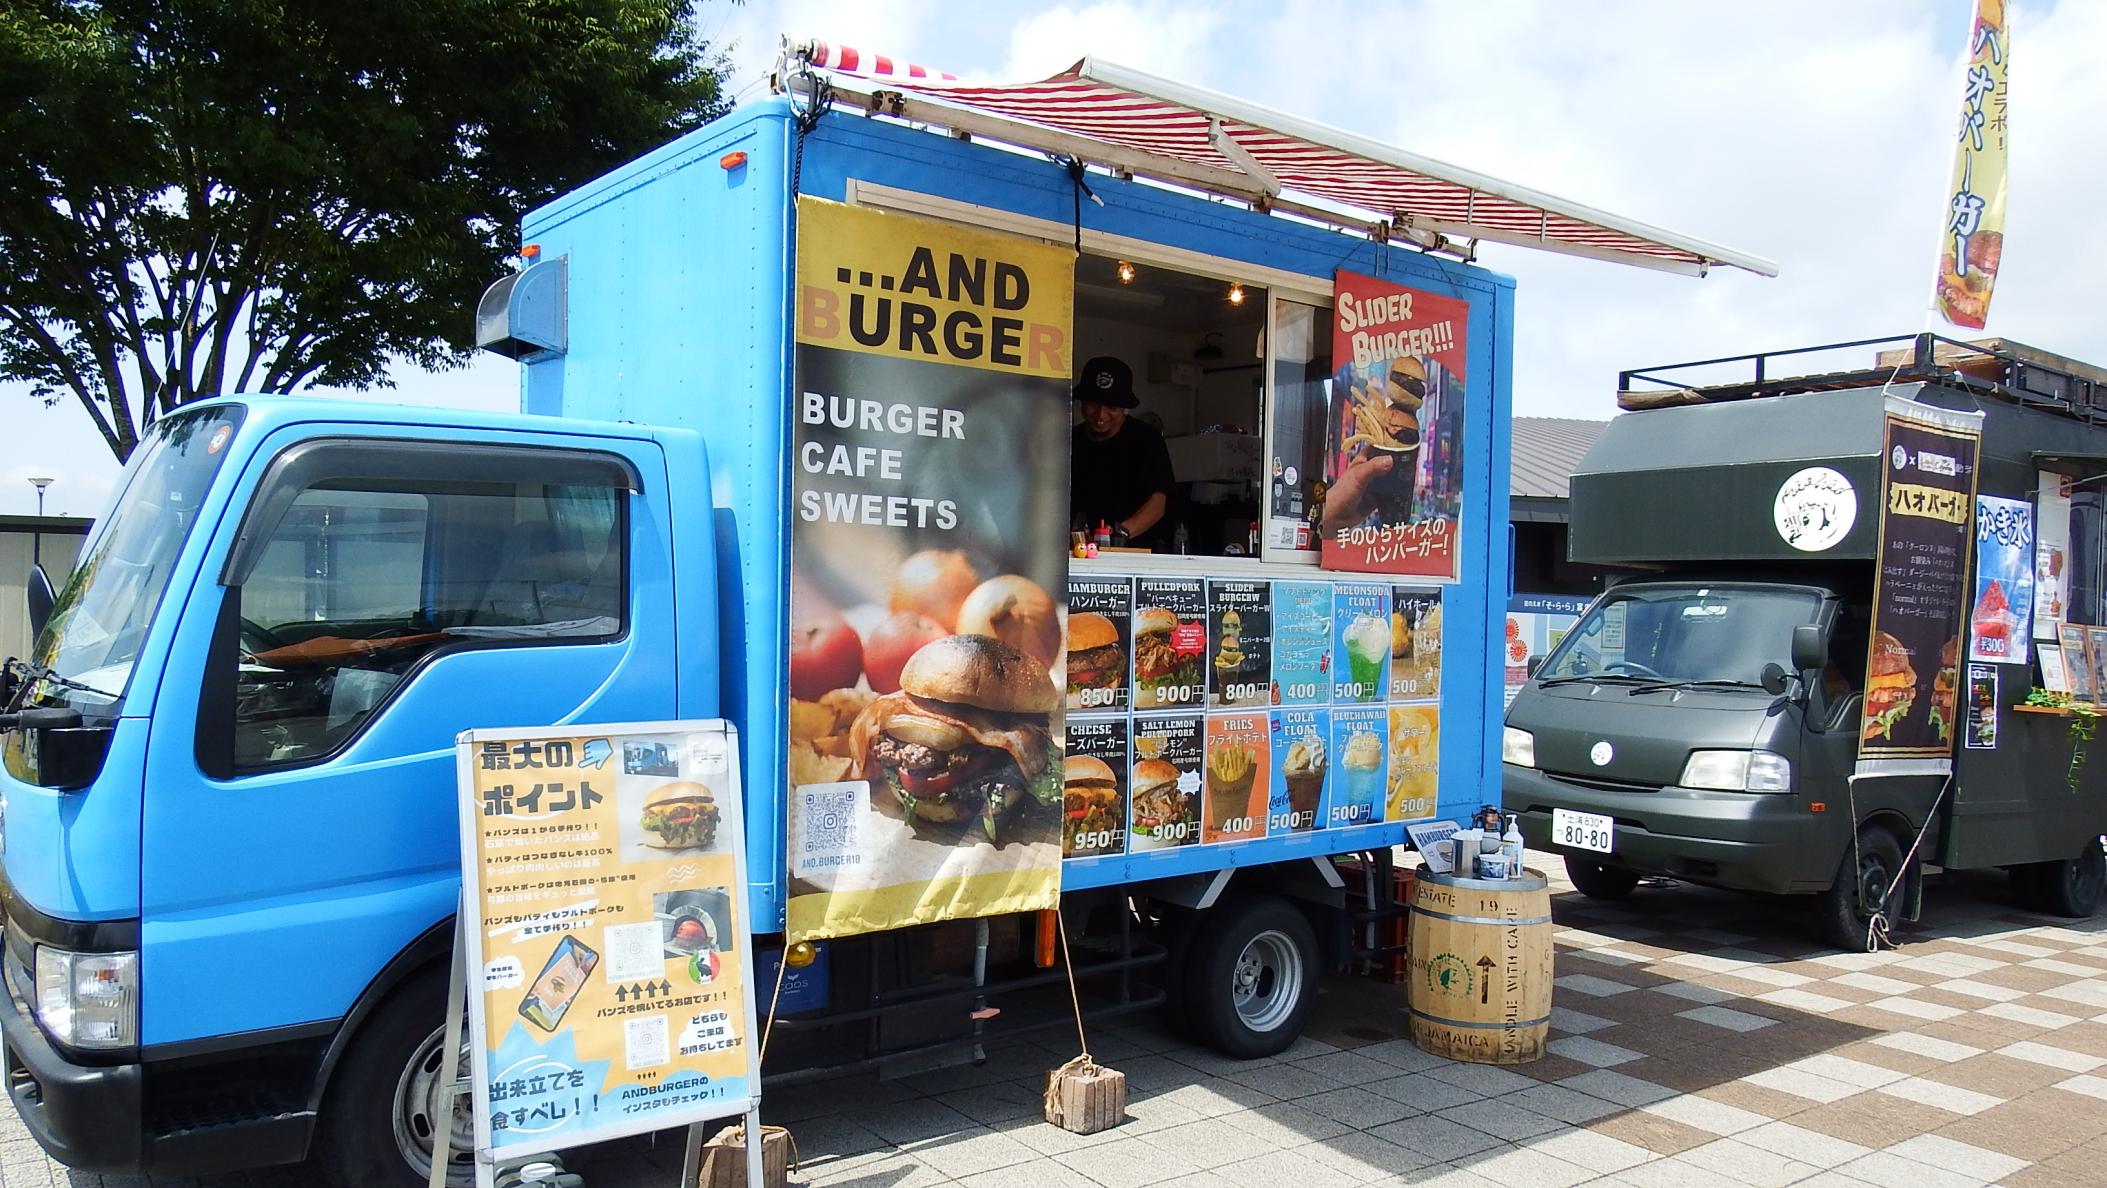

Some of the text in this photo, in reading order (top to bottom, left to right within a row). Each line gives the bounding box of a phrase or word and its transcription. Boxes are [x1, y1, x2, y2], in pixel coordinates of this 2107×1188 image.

[1949, 25, 2001, 276] ハオバーガー
[1338, 292, 1413, 333] SLIDER
[802, 285, 1065, 372] BURGER
[1351, 320, 1454, 369] BURGER!!!
[802, 391, 966, 440] BURGER
[801, 441, 903, 480] CAFE
[800, 490, 958, 530] SWEETS
[1336, 517, 1446, 549] 手のひらサイズの
[1978, 504, 2032, 549] かき氷
[1141, 582, 1200, 591] PULLEDPORK
[1225, 583, 1255, 592] SLIDER
[1334, 585, 1390, 596] MELONSODA
[1070, 596, 1126, 609] ハンバーガー
[1219, 593, 1260, 602] BURGERW
[1348, 597, 1377, 607] FLOAT
[1398, 598, 1437, 609] ハイボール
[1080, 687, 1129, 706] 850円
[1156, 685, 1204, 703] 900円
[1225, 682, 1269, 699] 800円
[1334, 682, 1374, 699] 500円
[1142, 719, 1196, 730] SALT LEMON
[1223, 719, 1254, 731] FRIES
[1287, 712, 1315, 723] COLA
[1346, 721, 1374, 731] FLOAT
[1070, 724, 1112, 735] CHEESE
[1141, 728, 1195, 738] PULLEDPORK
[1284, 724, 1318, 736] FLOAT
[1066, 736, 1126, 750] ーズバーガー
[481, 741, 573, 771] 最大の
[483, 781, 604, 816] ポイント
[1271, 810, 1313, 830] 500円
[1331, 803, 1371, 822] 500円
[1074, 829, 1125, 850] 950円
[1152, 821, 1200, 841] 900円
[1565, 825, 1608, 849] 80-80
[1506, 953, 1519, 993] WITH
[692, 1012, 728, 1025] どちらも
[697, 1026, 724, 1038] ご来店
[1425, 1025, 1489, 1048] JAMAICA
[679, 1037, 743, 1056] お待ちしてます
[488, 1069, 585, 1102] 出来立てを
[621, 1076, 709, 1100] ANDBURGERの
[490, 1093, 599, 1131] 食すべし！！
